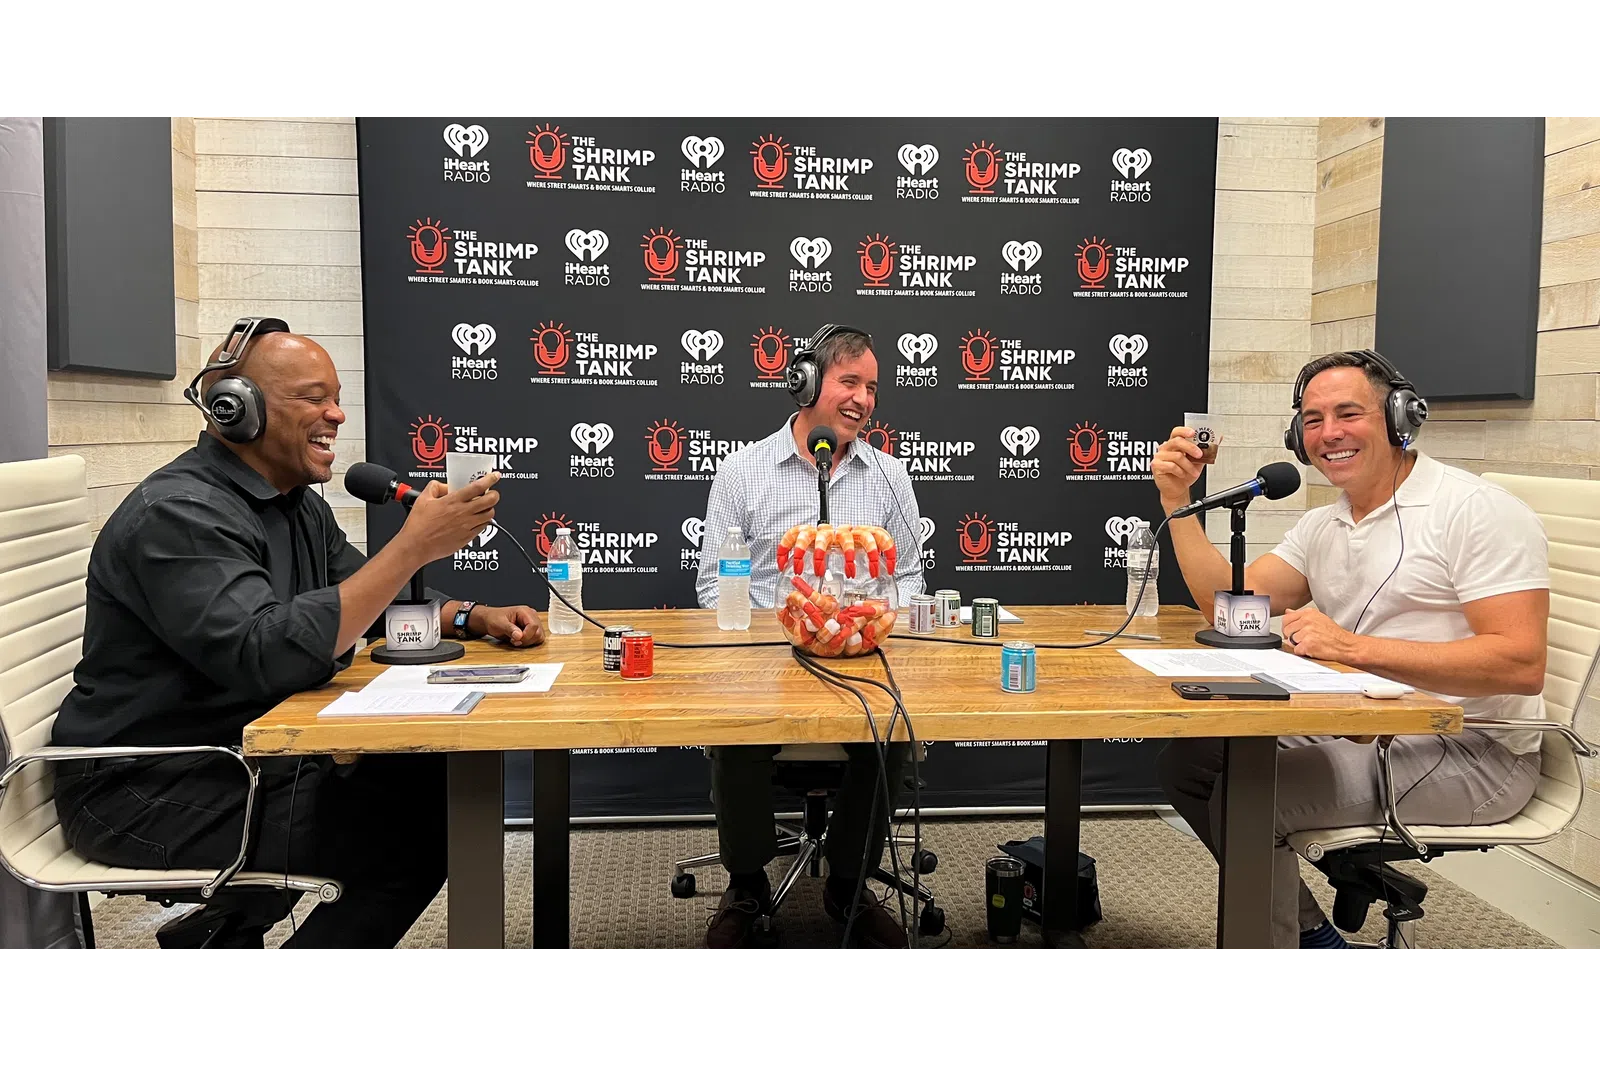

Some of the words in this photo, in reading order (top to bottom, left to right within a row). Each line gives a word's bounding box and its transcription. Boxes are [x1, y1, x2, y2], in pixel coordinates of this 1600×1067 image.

[571, 136, 595, 147] THE
[572, 147, 655, 166] SHRIMP
[793, 146, 816, 156] THE
[1004, 152, 1026, 162] THE
[444, 157, 490, 172] iHeart
[794, 156, 873, 174] SHRIMP
[1005, 162, 1081, 178] SHRIMP
[444, 170, 491, 183] RADIO
[572, 164, 630, 182] TANK
[681, 168, 725, 182] iHeart
[681, 181, 725, 193] RADIO
[793, 173, 849, 191] TANK
[897, 176, 938, 189] iHeart
[1004, 179, 1057, 195] TANK
[1111, 180, 1151, 192] iHeart
[897, 188, 939, 200] RADIO
[1110, 192, 1151, 202] RADIO
[453, 230, 477, 240] THE
[454, 241, 538, 259] SHRIMP
[685, 239, 708, 249] THE
[899, 245, 921, 254] THE
[1115, 247, 1136, 256] THE
[685, 249, 766, 267] SHRIMP
[899, 255, 976, 271] SHRIMP
[454, 258, 513, 276] TANK
[565, 262, 609, 275] iHeart
[1115, 257, 1189, 272] SHRIMP
[565, 274, 610, 286] RADIO
[685, 266, 741, 284] TANK
[790, 269, 832, 282] iHeart
[899, 272, 953, 287] TANK
[1001, 272, 1042, 284] iHeart
[789, 281, 832, 293] RADIO
[1114, 274, 1166, 289] TANK
[1000, 284, 1042, 295] RADIO
[575, 332, 598, 342] THE
[1000, 340, 1021, 349] THE
[576, 342, 658, 360] SHRIMP
[1000, 349, 1075, 365] SHRIMP
[452, 356, 497, 369] iHeart
[575, 360, 633, 376] TANK
[681, 361, 724, 374] iHeart
[452, 368, 498, 380] RADIO
[897, 365, 937, 376] iHeart
[999, 366, 1052, 381] TANK
[1108, 365, 1148, 377] iHeart
[681, 374, 724, 385] RADIO
[896, 376, 938, 387] RADIO
[1107, 377, 1148, 387] RADIO
[454, 426, 478, 436] THE
[688, 430, 711, 439] THE
[899, 432, 920, 440] THE
[1107, 431, 1128, 440] THE
[455, 437, 538, 453] SHRIMP
[899, 441, 975, 456] SHRIMP
[570, 455, 614, 467] iHeart
[999, 457, 1040, 468] iHeart
[570, 467, 614, 478] RADIO
[999, 469, 1040, 479] RADIO
[577, 523, 600, 532] THE
[997, 522, 1018, 531] THE
[577, 532, 658, 548] SHRIMP
[997, 532, 1072, 547] SHRIMP
[681, 548, 702, 560] iHe
[997, 548, 1049, 562] TANK
[454, 560, 499, 571] RADIO
[1104, 558, 1128, 568] RAD
